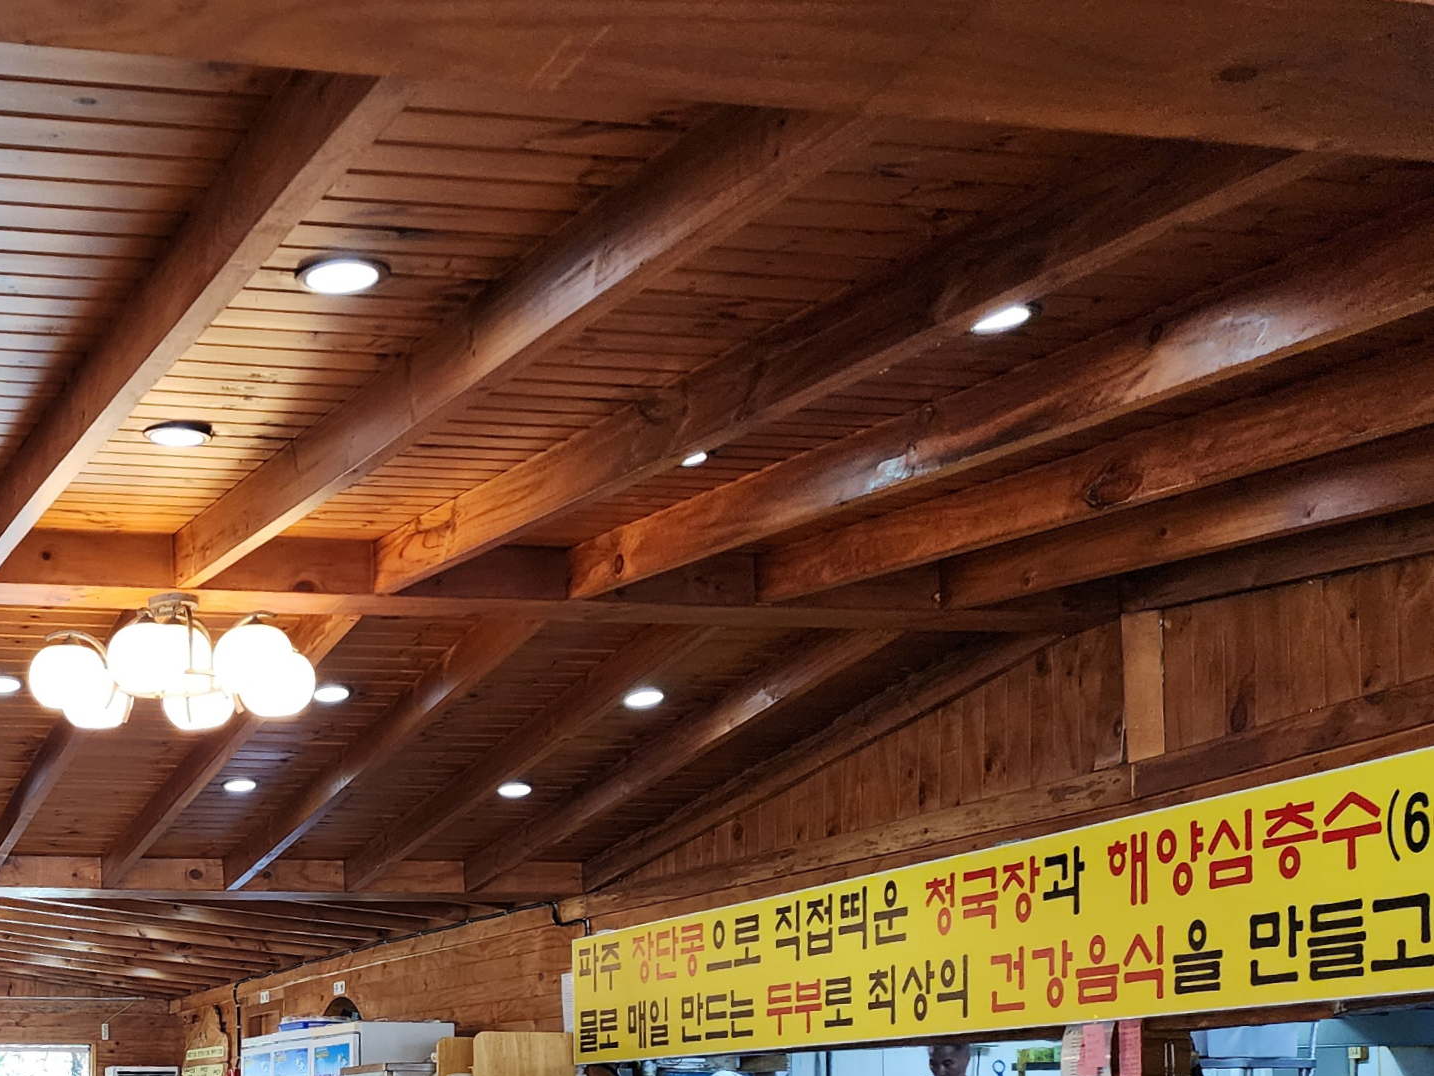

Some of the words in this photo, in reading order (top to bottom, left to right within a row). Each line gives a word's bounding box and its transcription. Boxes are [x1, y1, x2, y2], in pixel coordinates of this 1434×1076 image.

[578, 941, 622, 993] 파주
[631, 913, 761, 984] 장단콩으로
[774, 879, 909, 961] 직접띄운
[925, 845, 1085, 936] 청국장과
[1107, 789, 1434, 906] 해양심층수(6
[579, 1008, 619, 1053] 물로
[627, 997, 669, 1049] 매일
[680, 989, 754, 1044] 만드는
[766, 976, 854, 1036] 두부로
[867, 953, 968, 1025] 최상의
[990, 919, 1223, 1013] 건강음식을
[1249, 893, 1434, 987] 만들고
